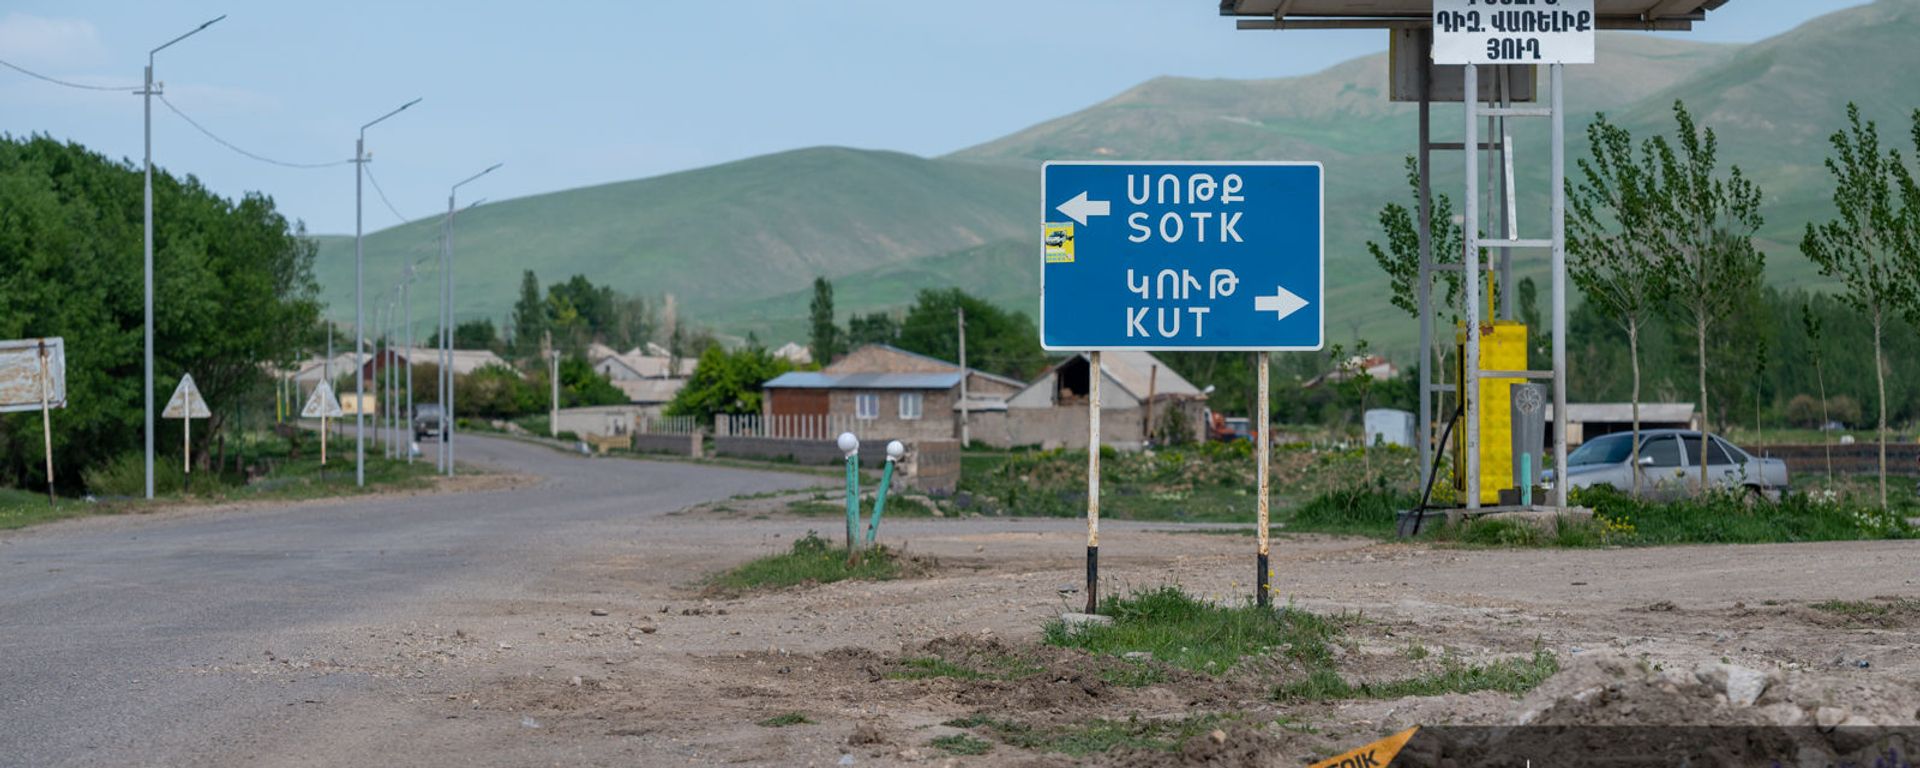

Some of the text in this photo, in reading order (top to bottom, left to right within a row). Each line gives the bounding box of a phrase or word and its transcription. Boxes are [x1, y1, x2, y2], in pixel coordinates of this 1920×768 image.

[1437, 11, 1591, 33] ԴԻԶ. ՎԱՌԵԼԻՔ
[1487, 38, 1541, 59] ՅՈՒՂ
[1128, 174, 1244, 204] ՍՈԹՔ
[1128, 212, 1244, 242] SOTK
[1127, 269, 1239, 299] ԿՈՒԹ
[1127, 307, 1210, 337] KUT
